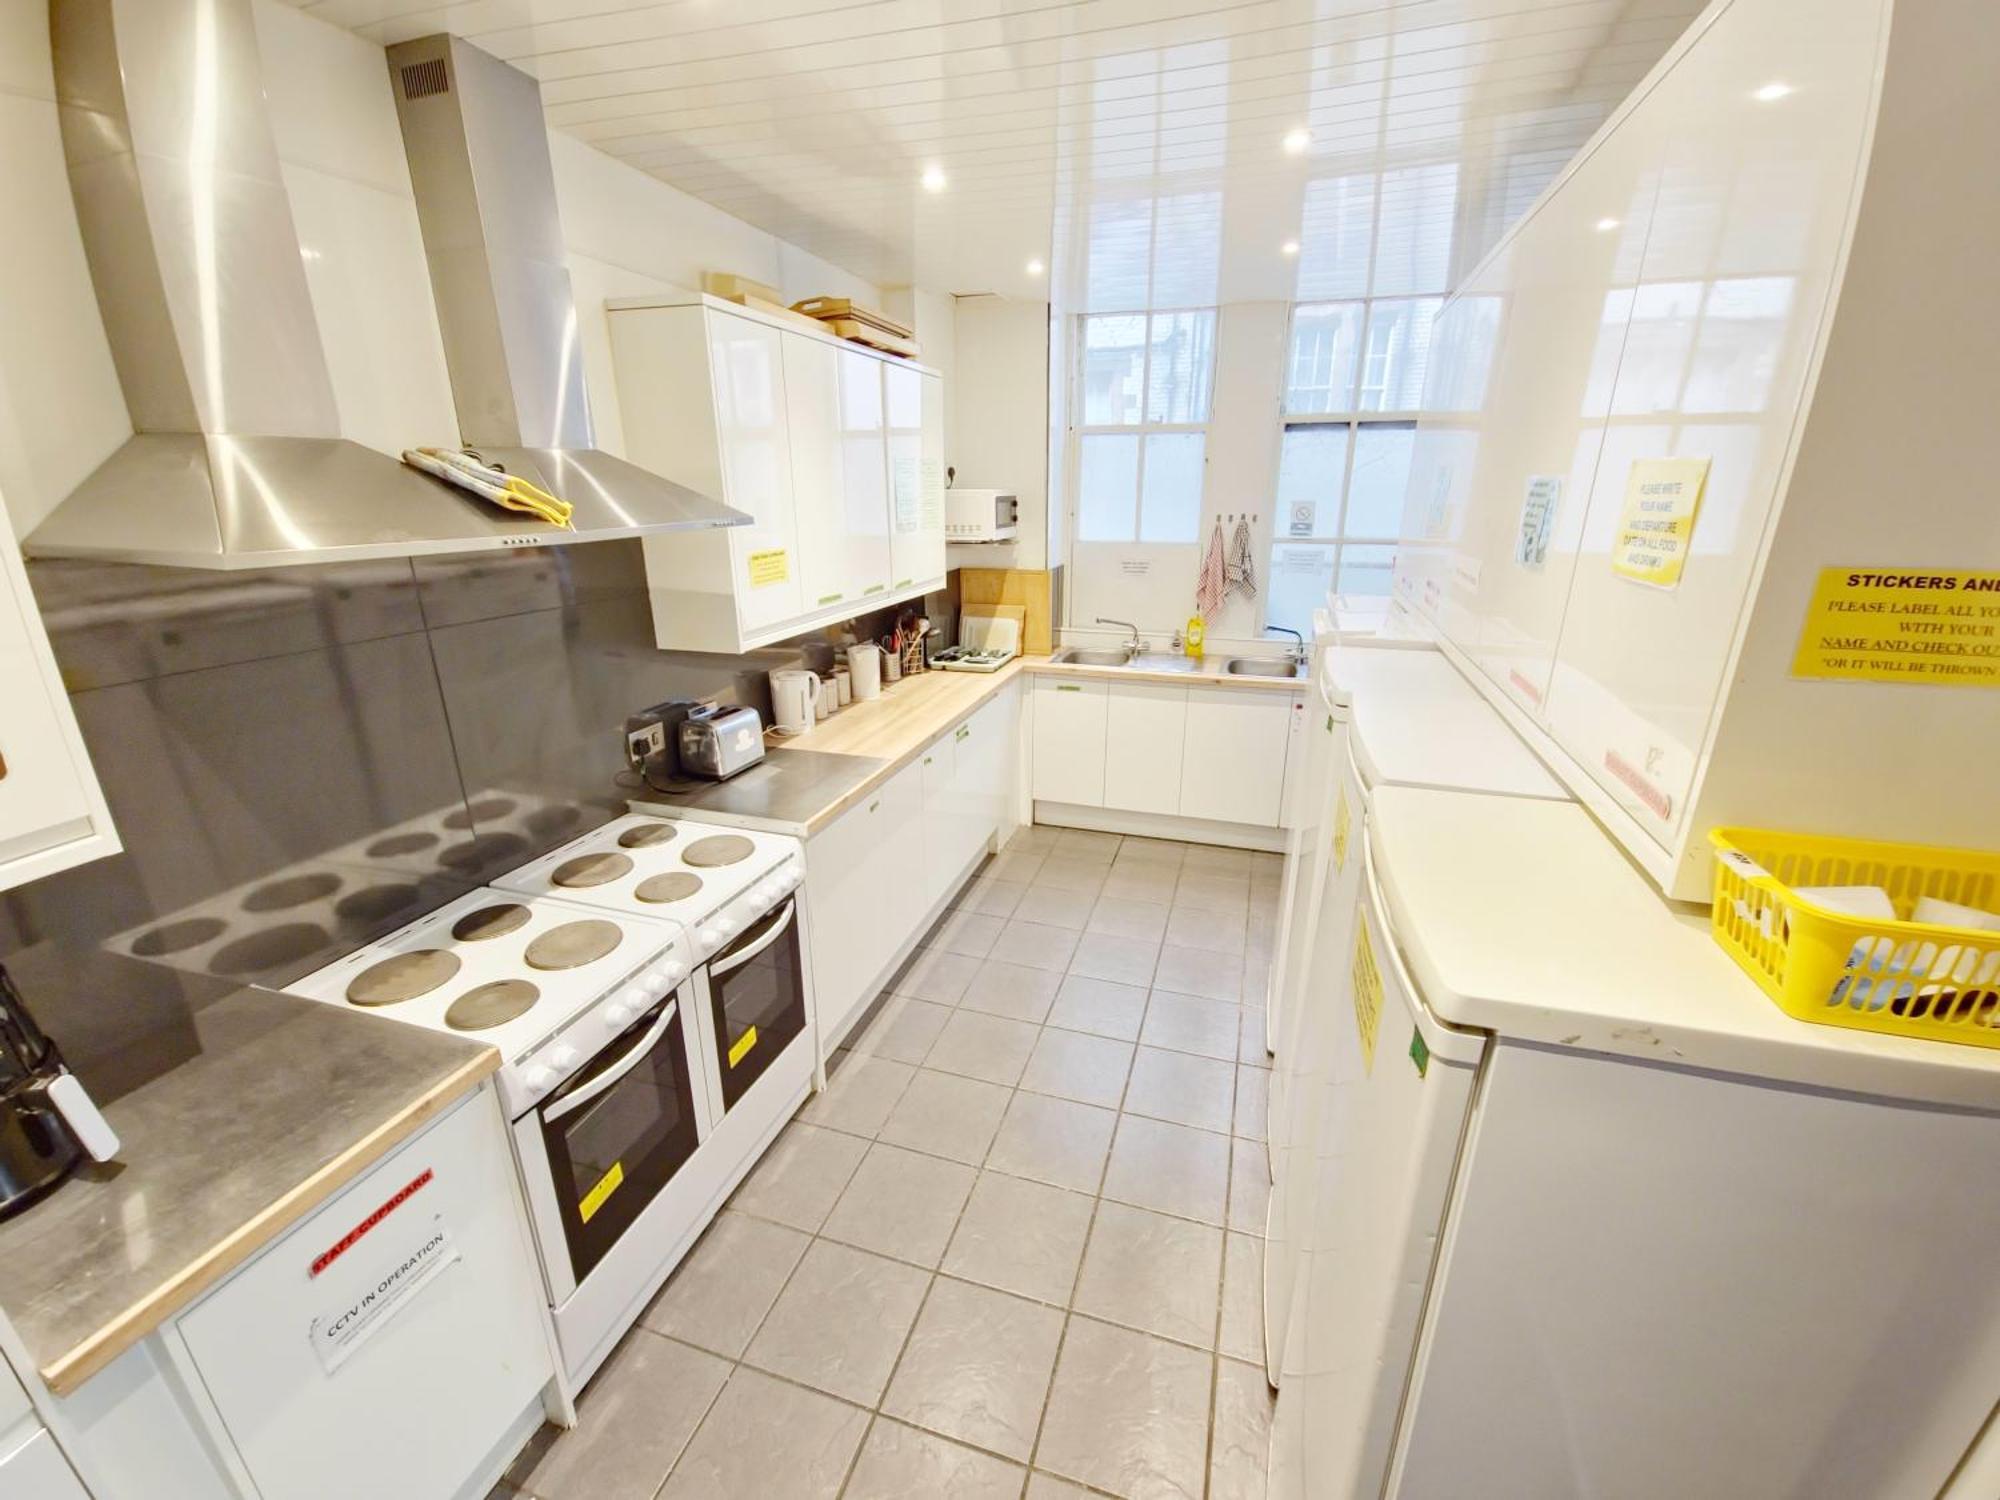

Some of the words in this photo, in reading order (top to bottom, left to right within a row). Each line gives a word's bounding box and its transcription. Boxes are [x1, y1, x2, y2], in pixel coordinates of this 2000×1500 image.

[1847, 574, 1957, 590] STICKERS
[1827, 601, 1885, 614] PLEASE
[1890, 603, 1940, 615] LABEL
[1943, 605, 1975, 617] ALL
[1899, 622, 1944, 635] WITH
[1949, 624, 1995, 637] YOUR
[1820, 637, 1867, 650] NAME
[1874, 639, 1909, 651] AND
[1911, 641, 1968, 655] CHECK
[1851, 659, 1865, 670] IT
[1869, 660, 1904, 672] WILL
[1908, 662, 1927, 673] BE
[1930, 663, 1995, 676] THROWN
[312, 1232, 355, 1274] STAFF
[360, 1171, 431, 1234] CUPBOARD
[328, 1306, 358, 1337] CCTV
[362, 1292, 375, 1308] IN
[378, 1233, 443, 1293] OPERATION
